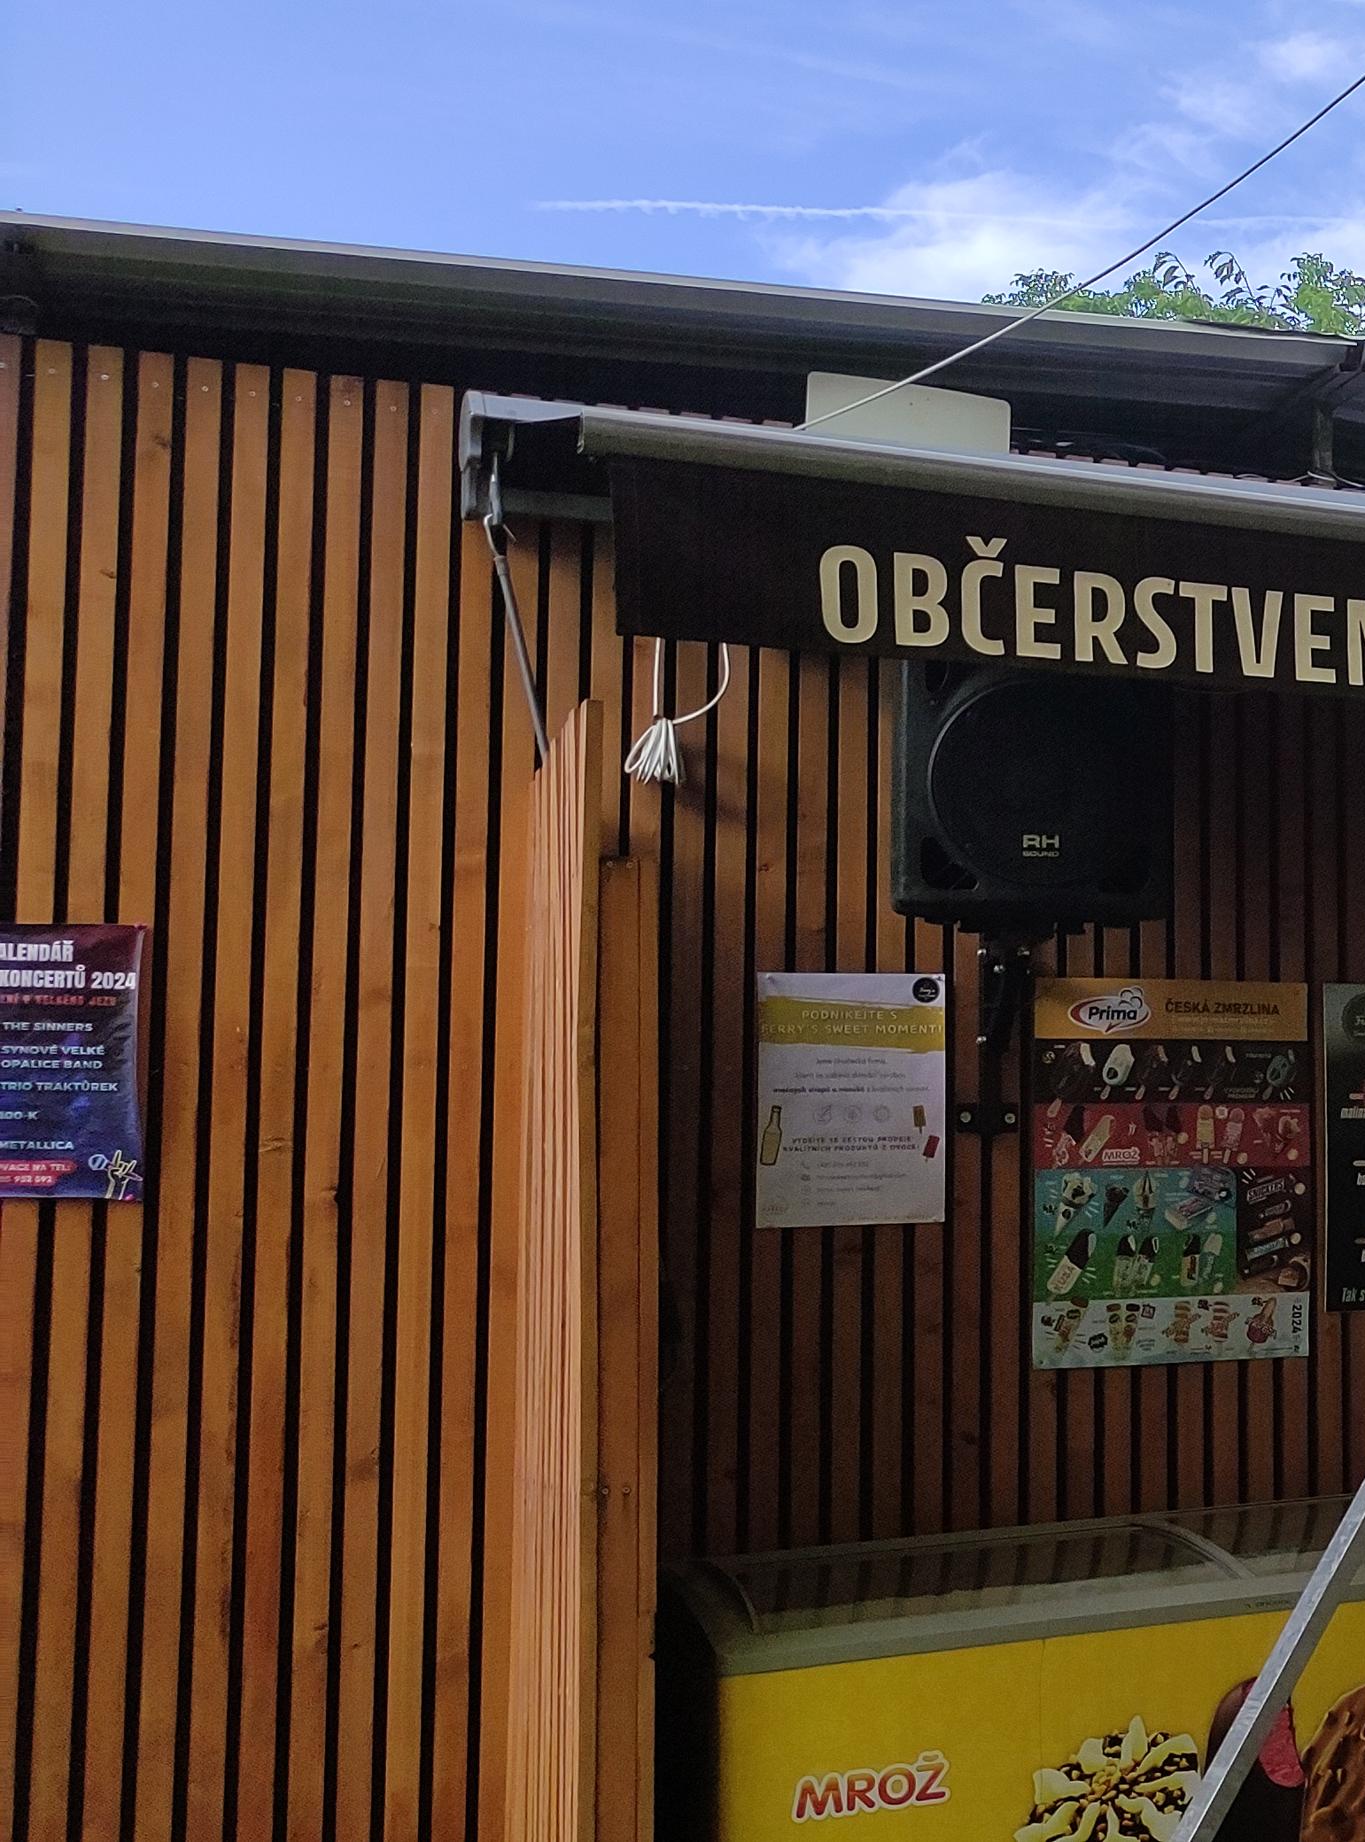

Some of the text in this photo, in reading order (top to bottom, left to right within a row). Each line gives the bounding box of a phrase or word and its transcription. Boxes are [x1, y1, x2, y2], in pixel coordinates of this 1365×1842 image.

[1022, 834, 1060, 848] RH
[0, 939, 75, 963] ALENDÁŘ
[0, 964, 137, 990] KONCERTŮ 2024
[802, 1009, 885, 1021] PODNIKEJTE
[1088, 1006, 1137, 1022] Prima
[1165, 999, 1281, 1016] ČESKÁ ZMRZLINA
[3, 1021, 94, 1033] THE SINNERS
[824, 1024, 868, 1035] SWEET
[1, 1044, 105, 1058] SYNOVÉ VELKÉ
[1, 1059, 103, 1070] OPALICE BAND
[1, 1082, 33, 1092] TRIO
[1342, 1287, 1358, 1303] Tak
[1291, 1304, 1303, 1334] 2024
[794, 1751, 949, 1822] MROŽ
